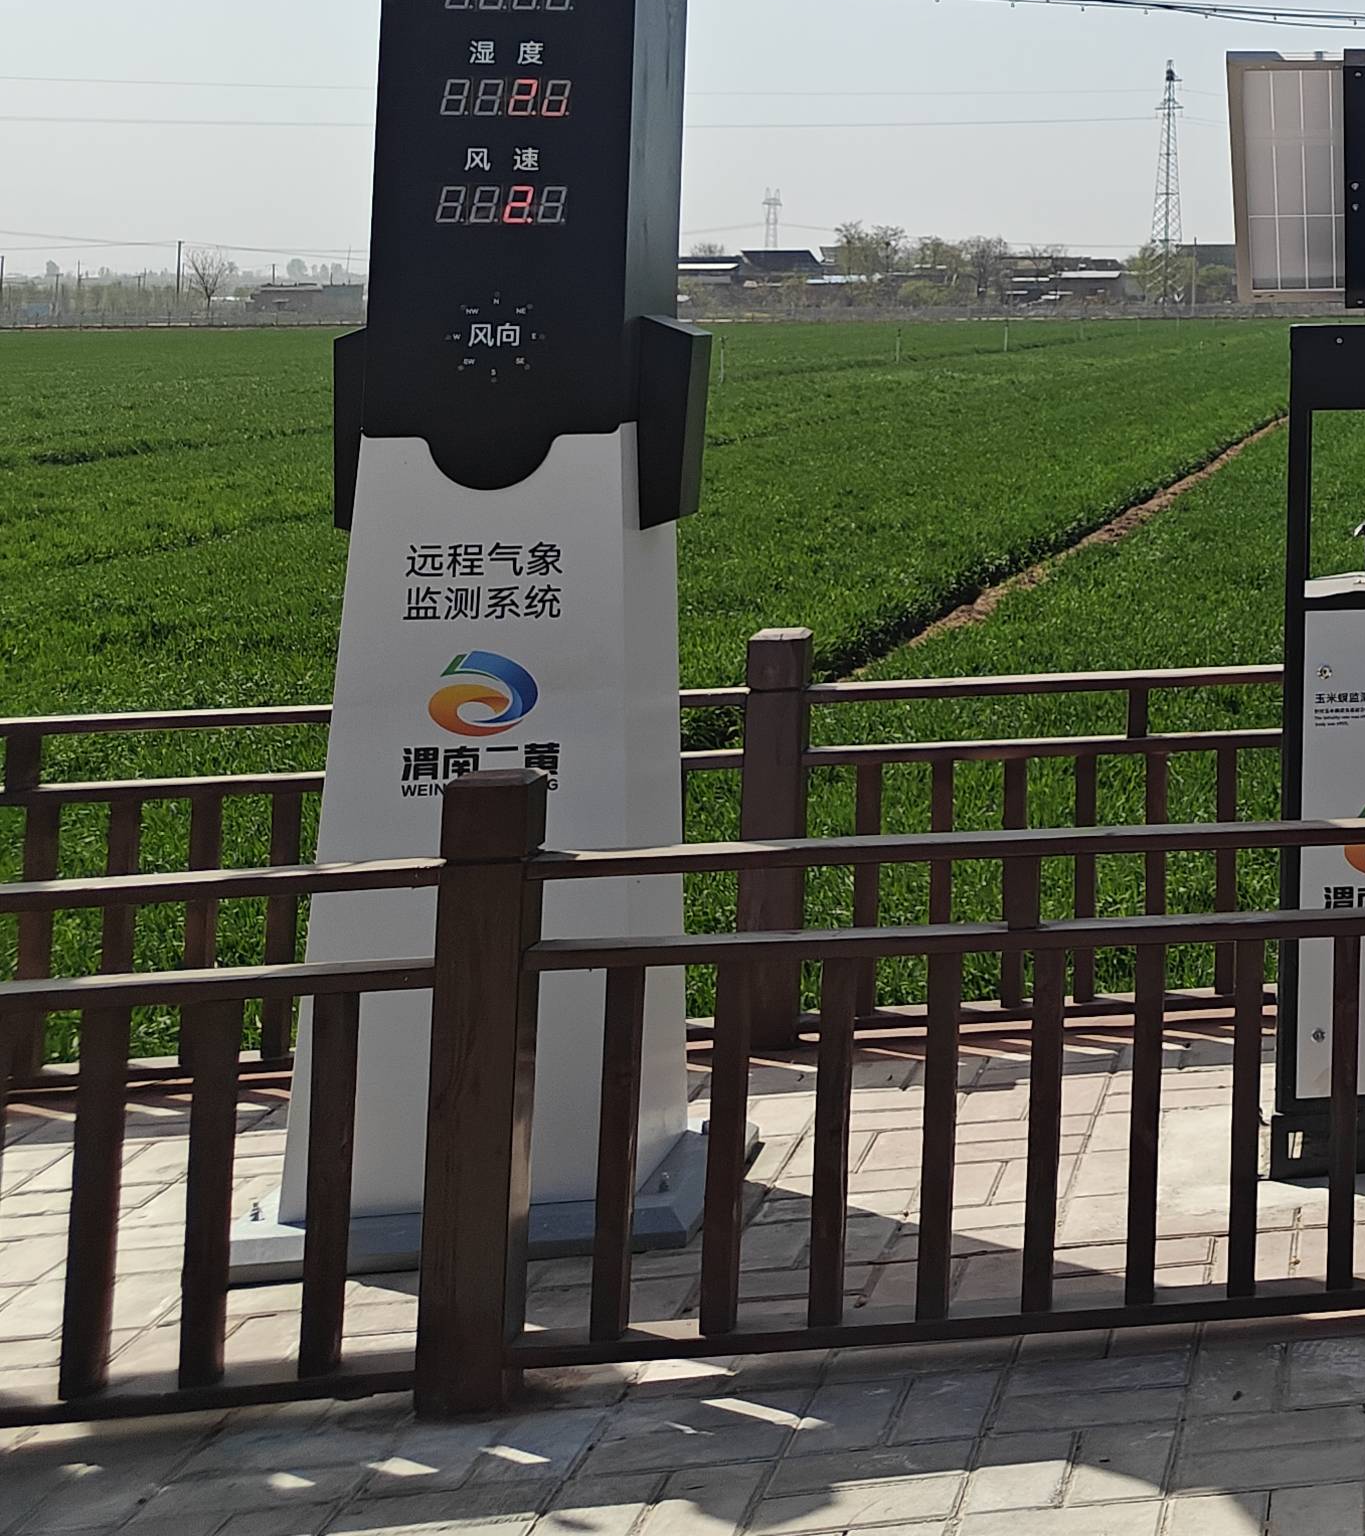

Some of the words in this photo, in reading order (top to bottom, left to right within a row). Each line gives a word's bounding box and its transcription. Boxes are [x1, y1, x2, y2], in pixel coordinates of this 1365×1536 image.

[468, 322, 521, 347] 风向
[405, 541, 563, 578] 远程气象
[402, 584, 562, 620] 监测系统
